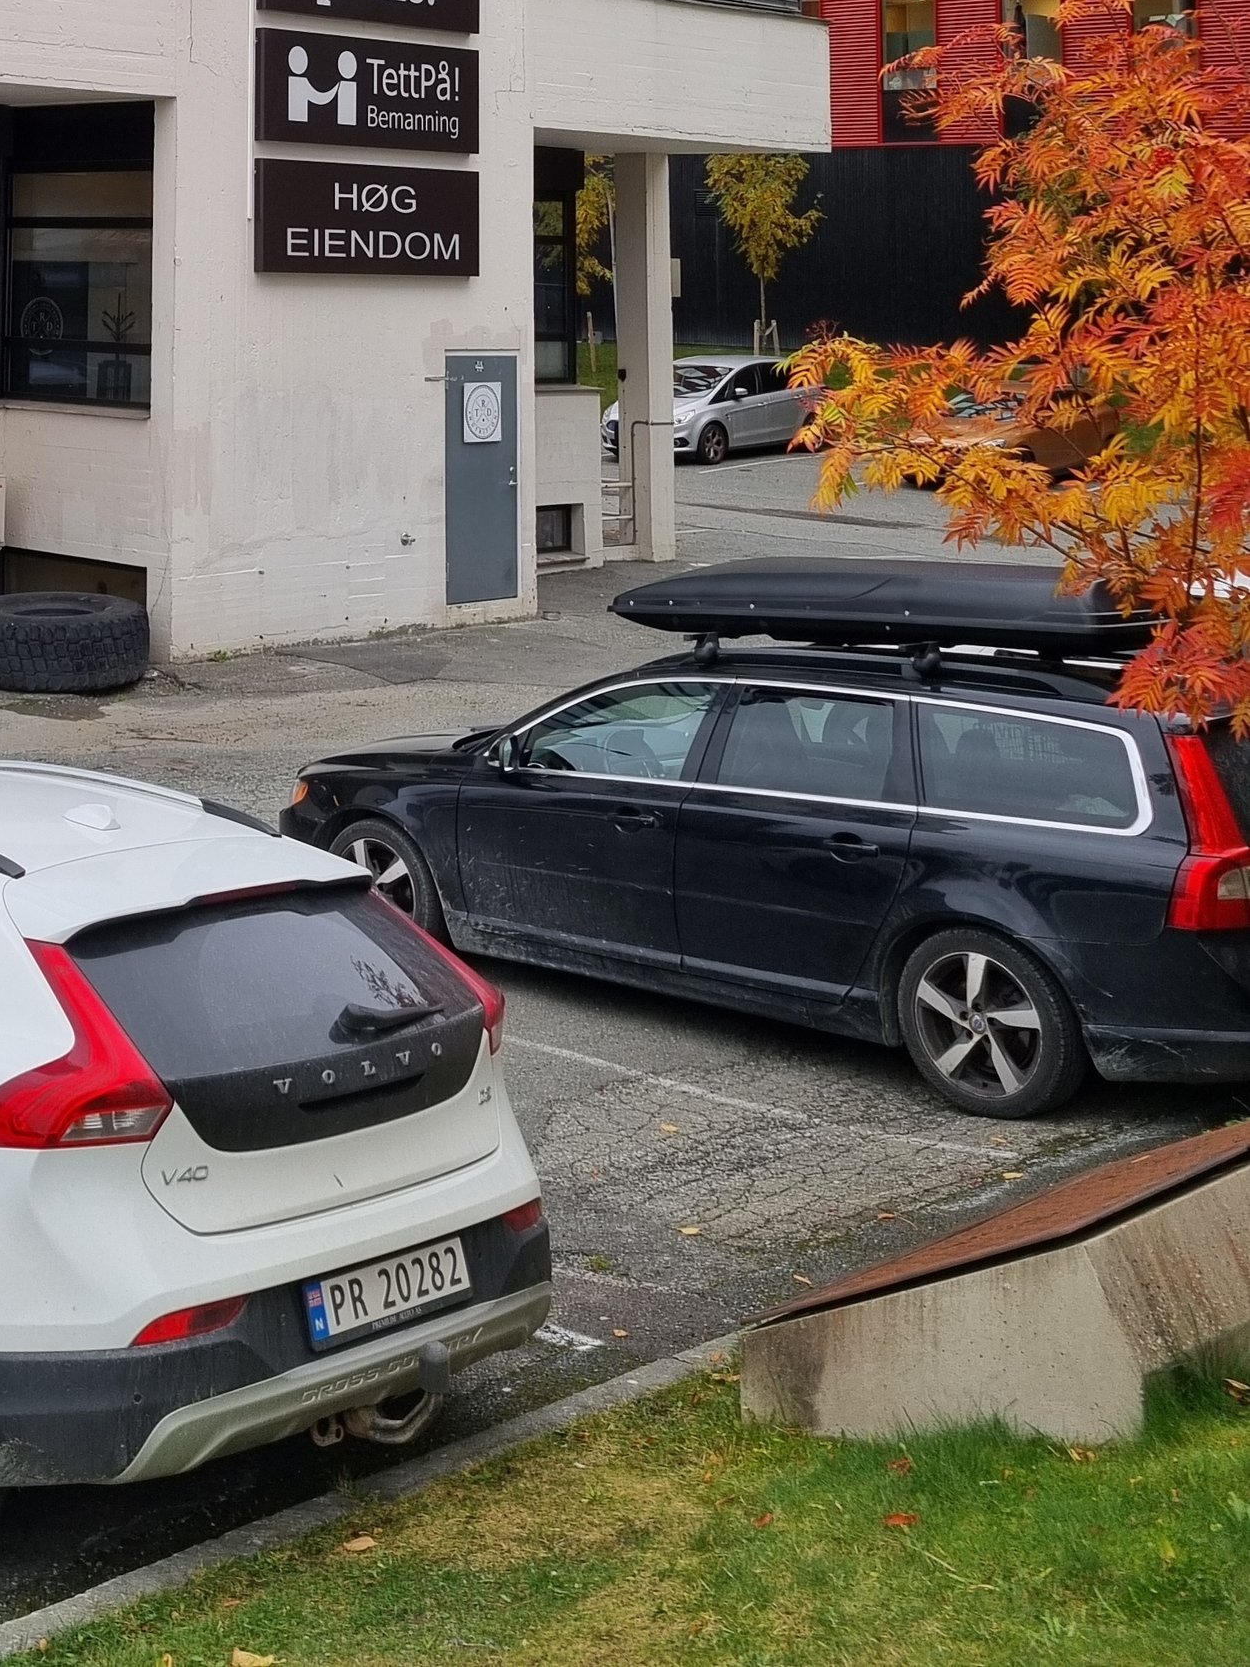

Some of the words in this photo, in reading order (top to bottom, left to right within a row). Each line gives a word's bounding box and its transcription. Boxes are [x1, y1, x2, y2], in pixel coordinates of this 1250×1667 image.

[366, 58, 460, 102] TettPå!
[367, 105, 460, 139] Bemanning
[334, 182, 417, 214] HØG
[286, 227, 461, 261] EIENDOM
[272, 1041, 443, 1094] VOLVO
[161, 1165, 209, 1186] V40
[329, 1277, 369, 1327] PR
[377, 1246, 463, 1310] 20282
[314, 1318, 325, 1332] N
[301, 1367, 382, 1407] CROSS
[387, 1325, 484, 1376] COTRY
